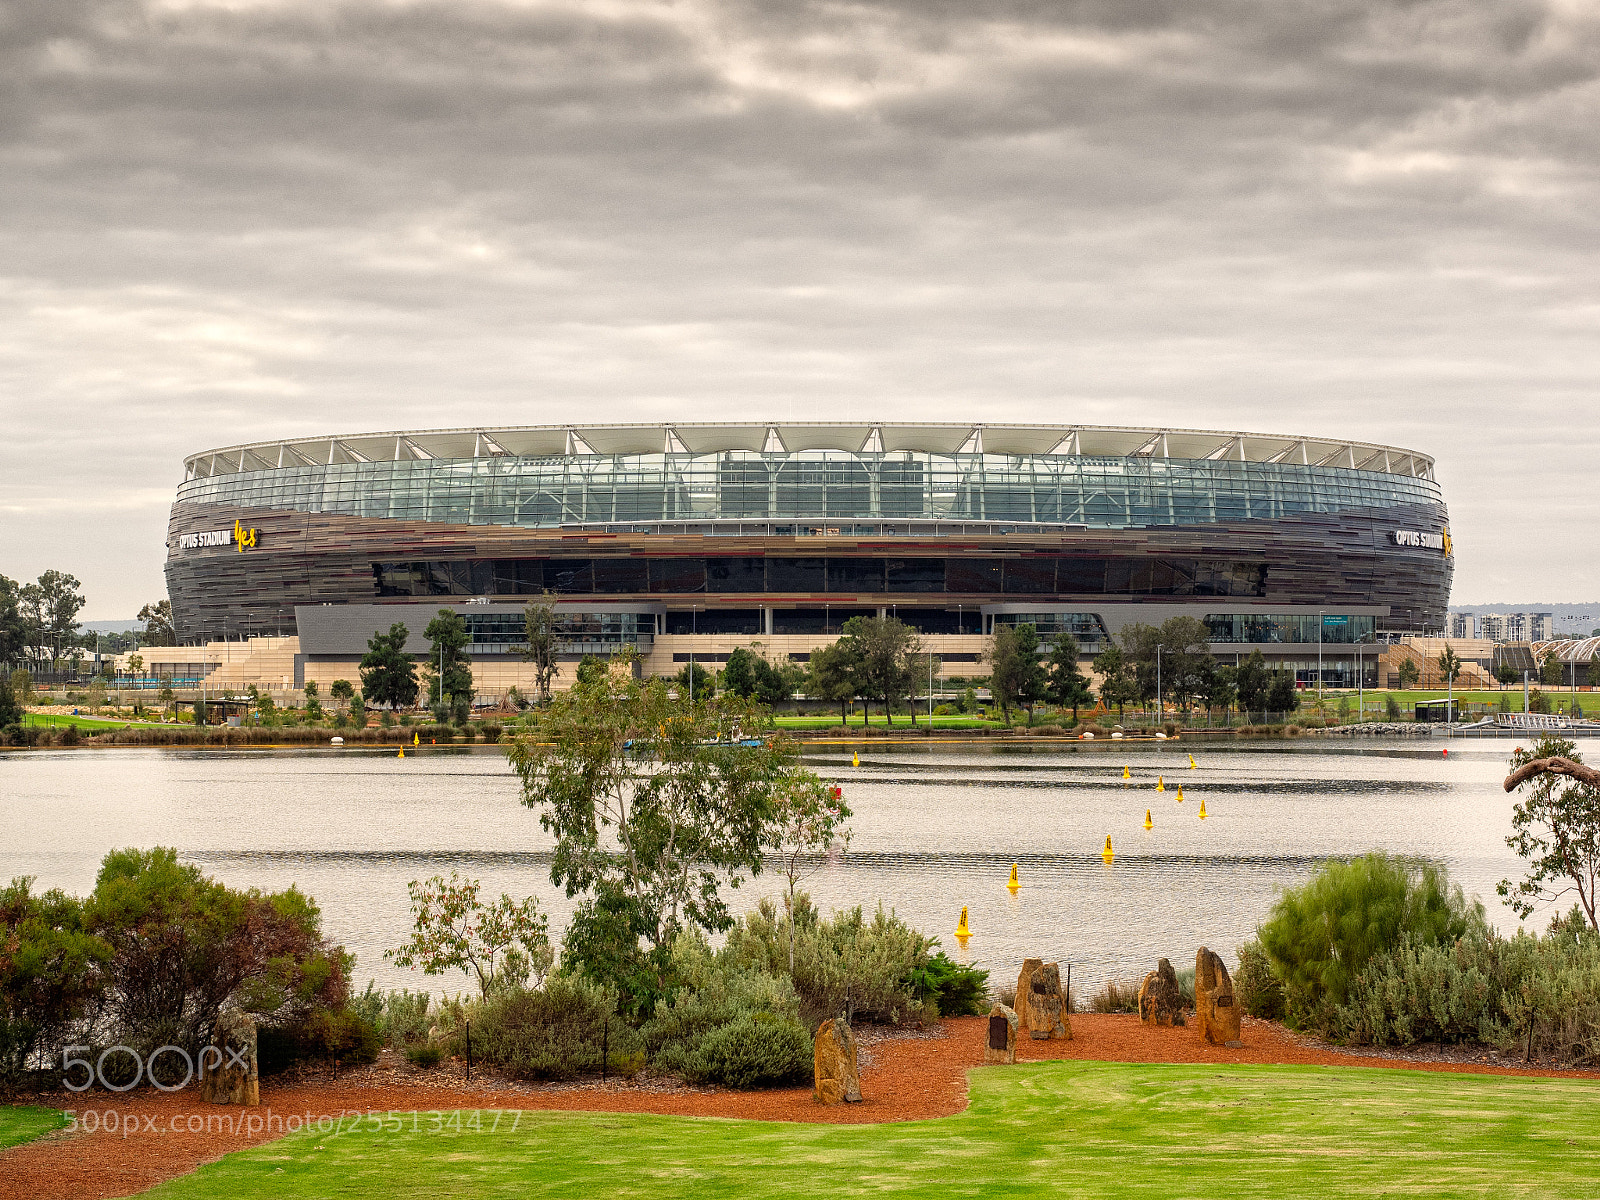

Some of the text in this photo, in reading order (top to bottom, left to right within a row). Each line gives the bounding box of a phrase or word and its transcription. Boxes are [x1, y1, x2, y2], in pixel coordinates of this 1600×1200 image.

[179, 530, 231, 549] OPTUS STADIUM
[1396, 530, 1420, 547] OPTUS
